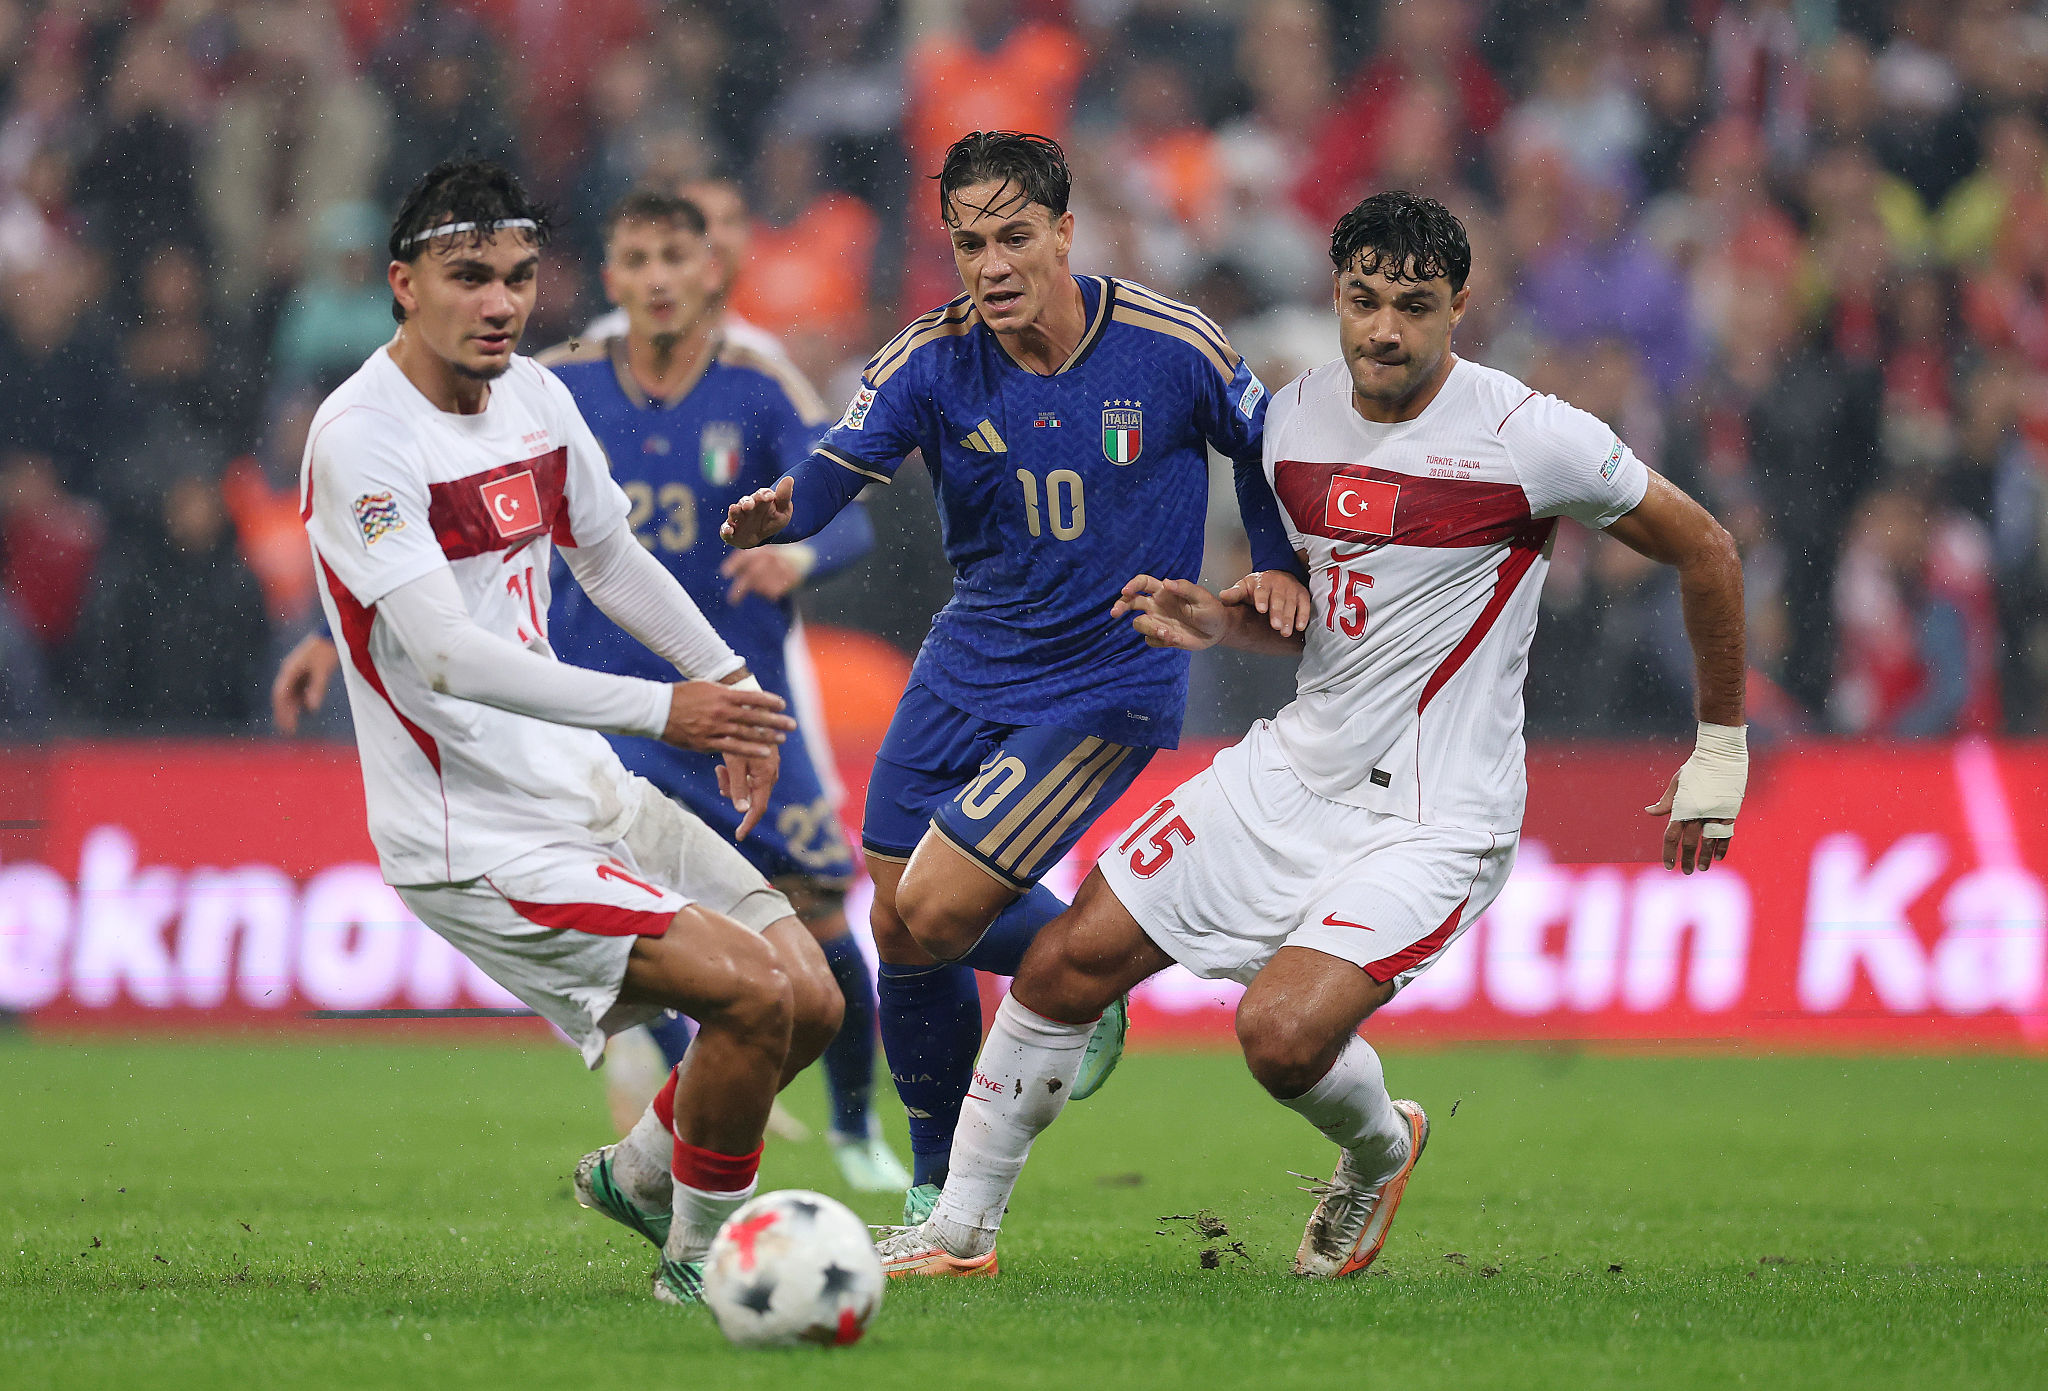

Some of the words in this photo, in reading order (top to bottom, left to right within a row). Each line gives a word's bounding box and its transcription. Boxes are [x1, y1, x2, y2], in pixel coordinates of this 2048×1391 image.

[1105, 413, 1139, 425] ITALIA
[623, 480, 699, 552] 23
[1016, 468, 1085, 542] 10
[1326, 565, 1375, 640] 15
[953, 749, 1027, 820] 10
[1117, 799, 1196, 880] 15
